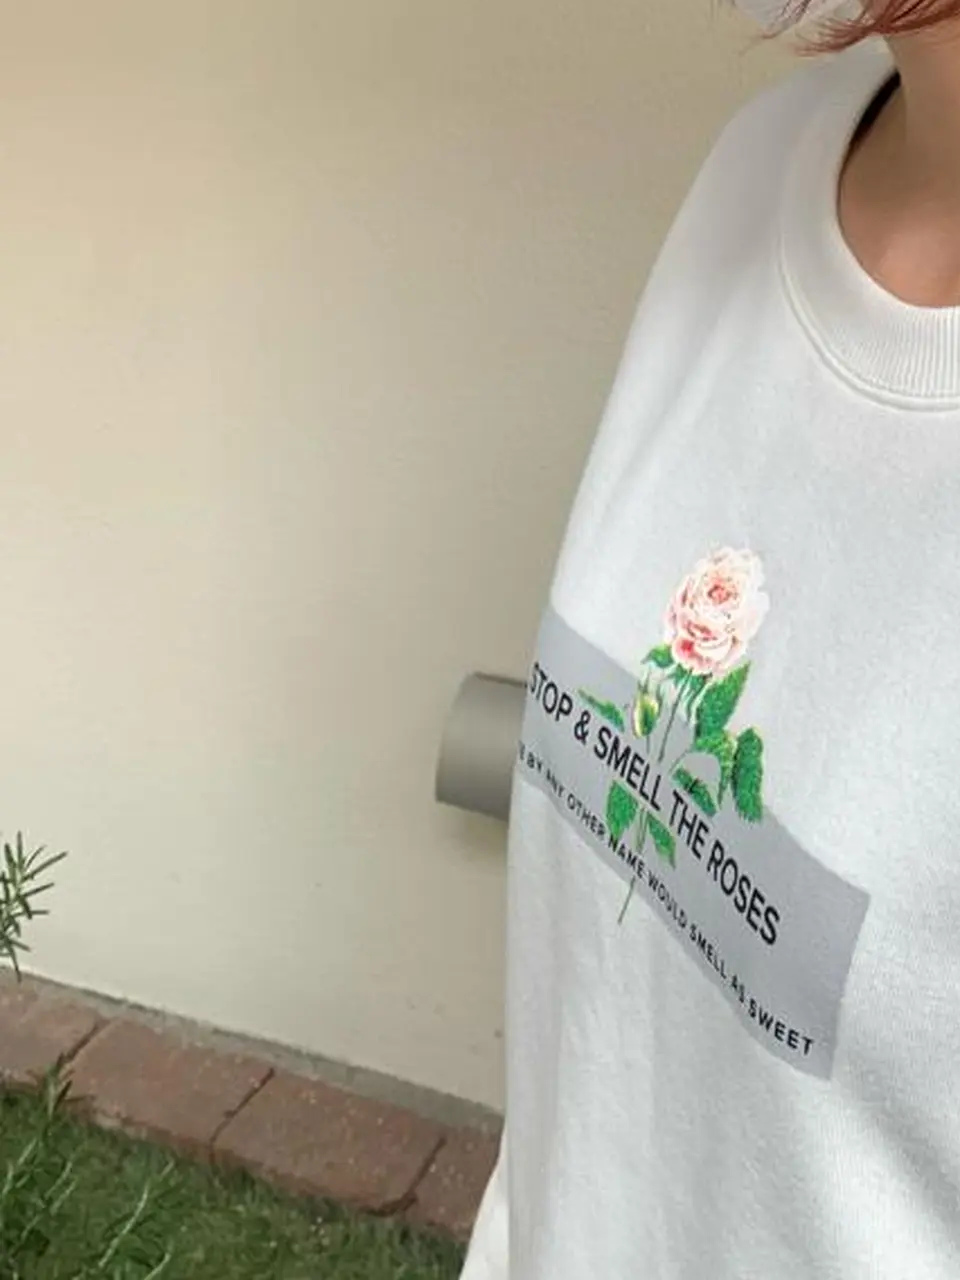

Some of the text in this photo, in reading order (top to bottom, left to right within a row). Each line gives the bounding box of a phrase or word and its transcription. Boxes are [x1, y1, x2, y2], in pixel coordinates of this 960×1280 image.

[526, 751, 815, 1056] BY ANY OTHER NAME WOULD SMELL AS SWEET
[573, 710, 592, 746] &
[593, 726, 661, 812] SMELL
[669, 789, 710, 860] THE
[706, 839, 781, 946] ROSES
